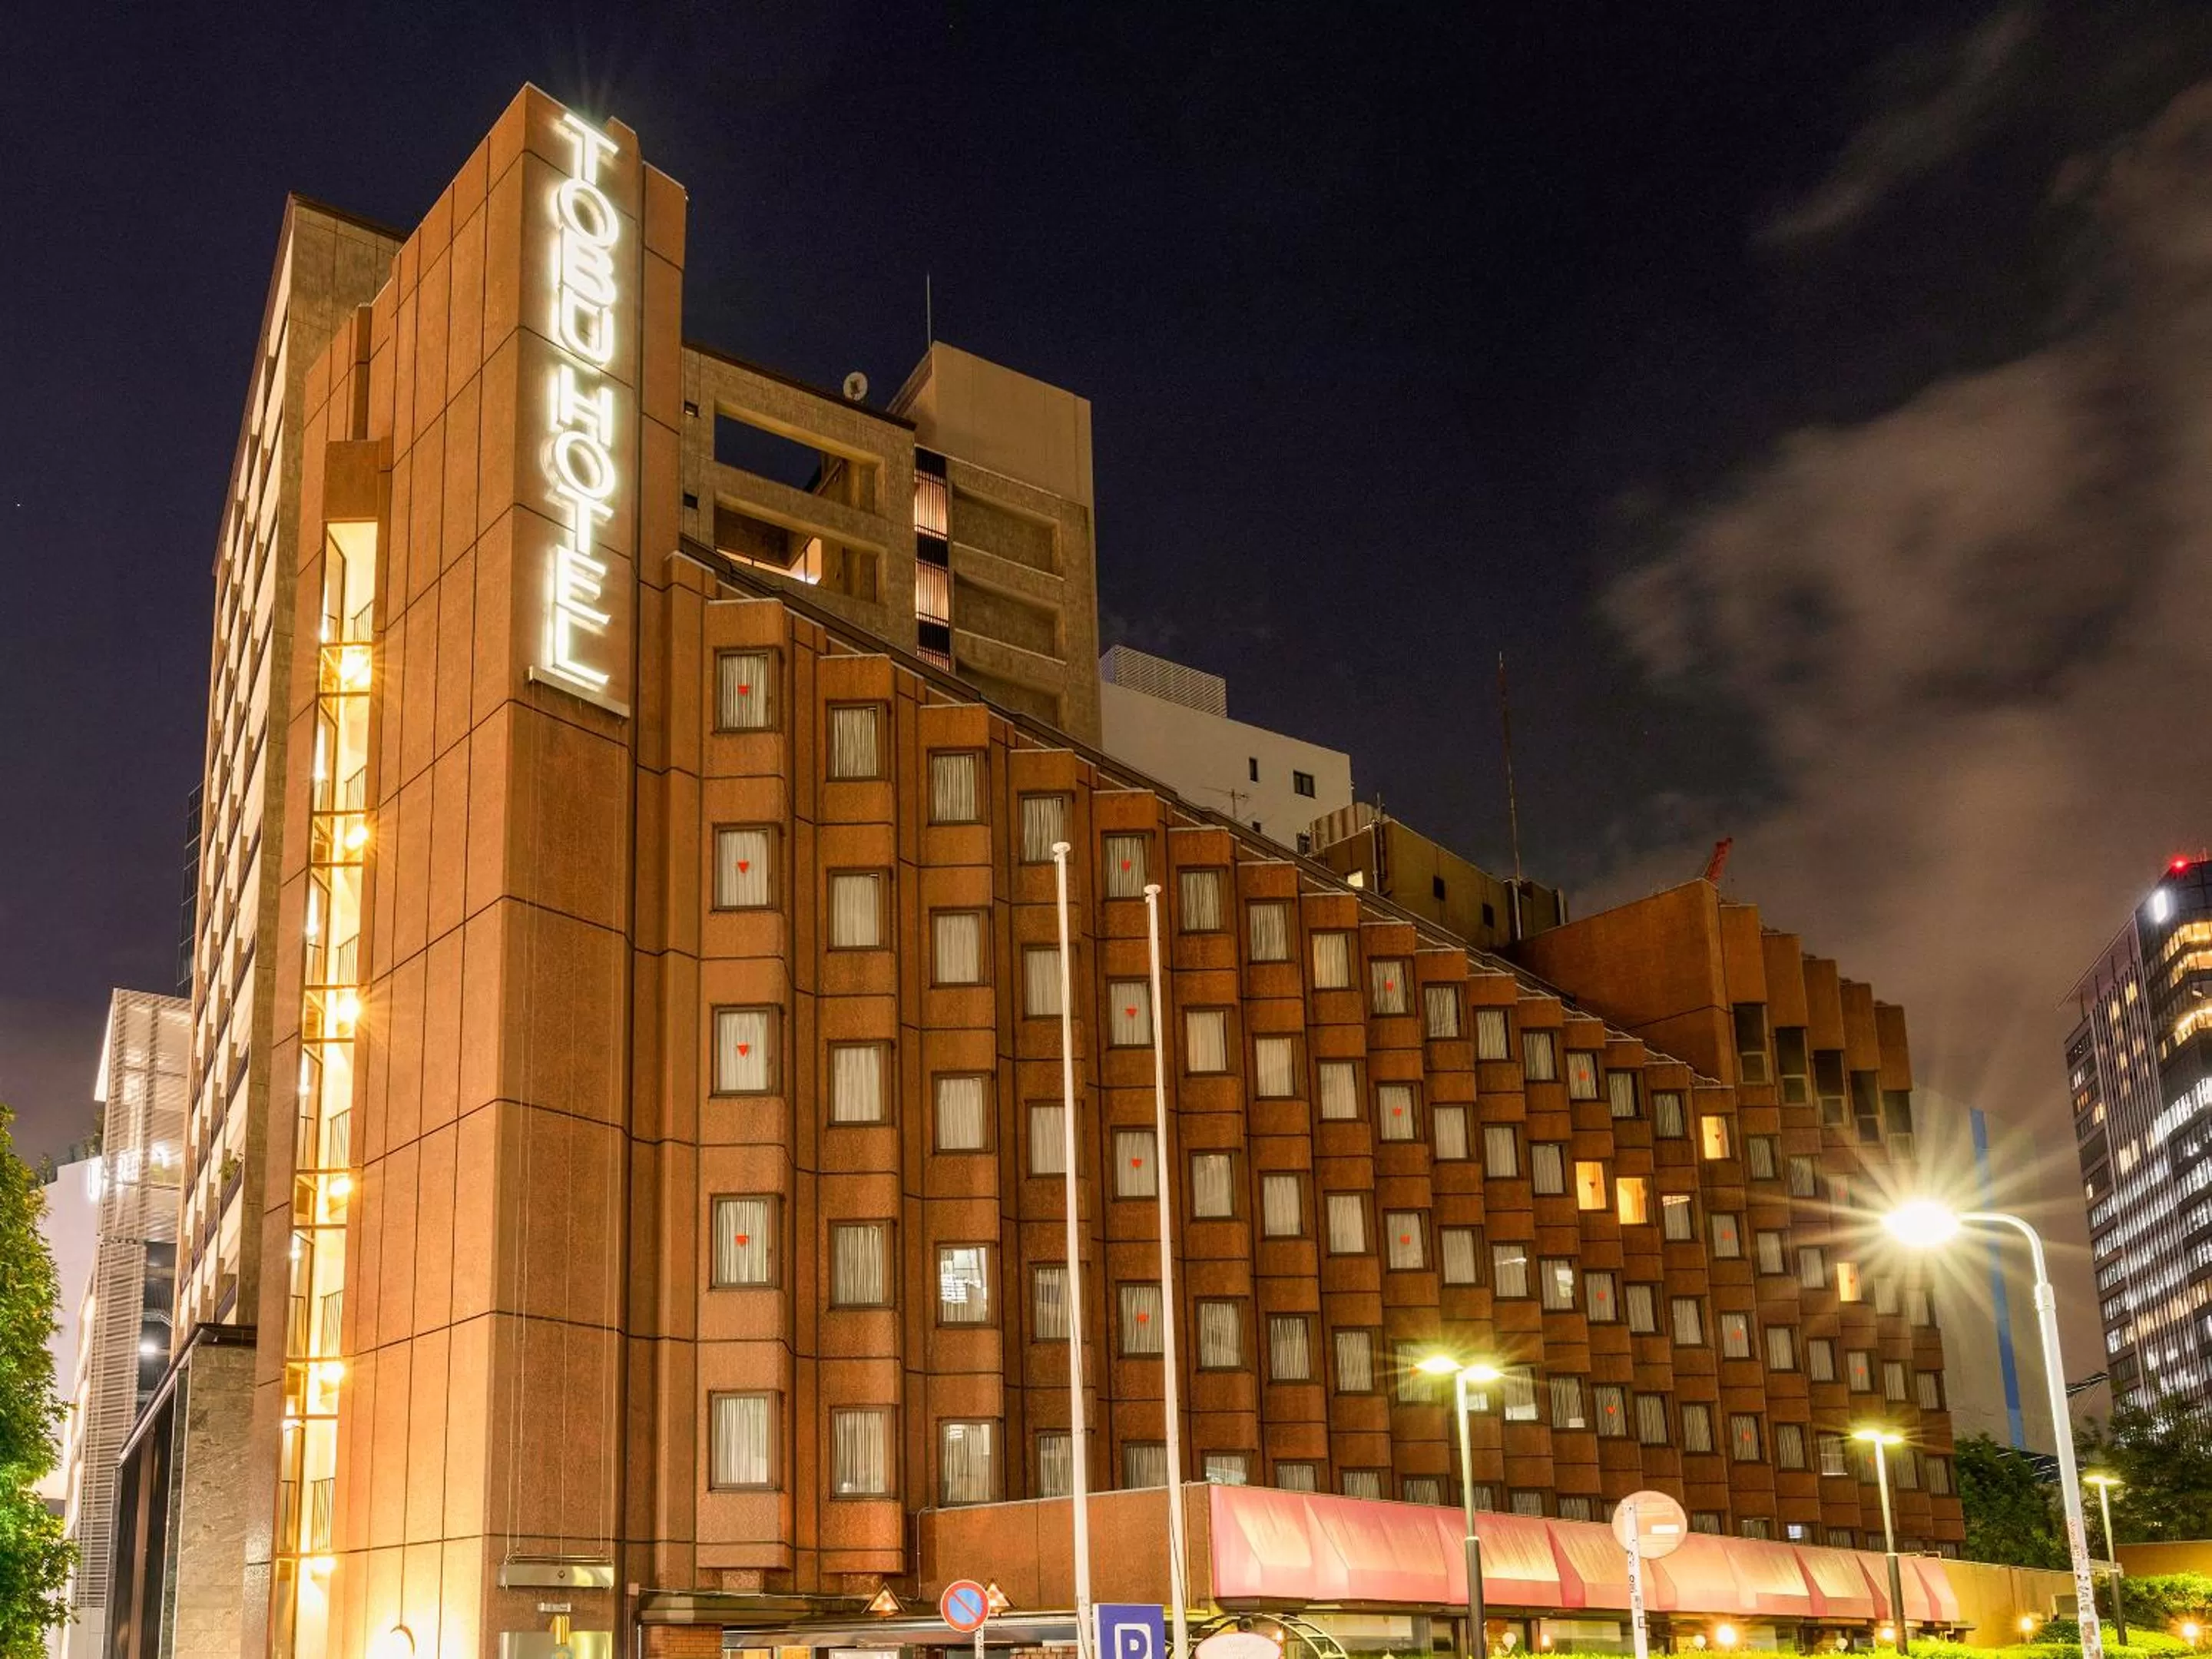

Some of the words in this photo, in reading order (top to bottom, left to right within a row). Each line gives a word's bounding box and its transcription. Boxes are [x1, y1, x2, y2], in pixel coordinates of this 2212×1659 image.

[558, 112, 619, 365] TOBU
[551, 364, 617, 686] HOTEL
[1119, 1628, 1149, 1659] P
